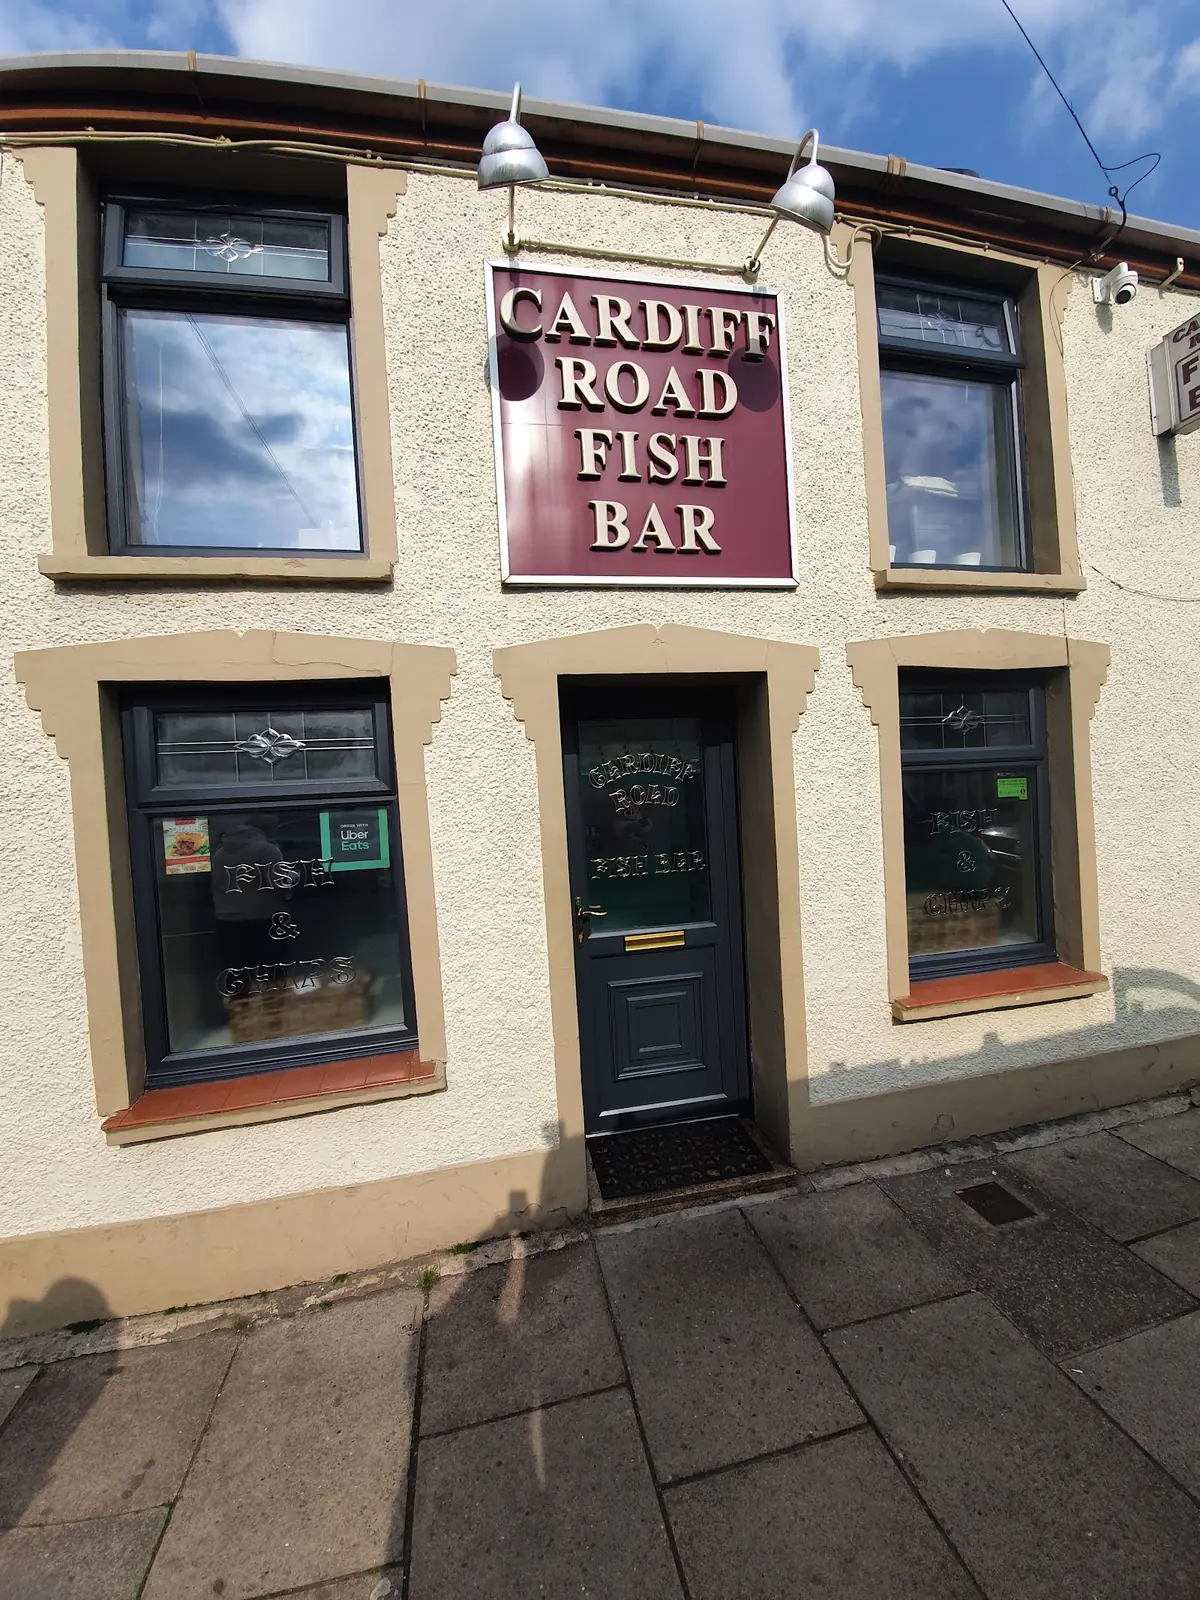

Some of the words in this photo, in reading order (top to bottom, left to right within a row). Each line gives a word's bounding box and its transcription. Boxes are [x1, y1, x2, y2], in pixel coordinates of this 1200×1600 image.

[500, 287, 775, 361] CARDIFF
[555, 356, 738, 420] ROAD
[574, 428, 727, 487] FISH
[588, 500, 722, 554] BAR
[588, 752, 697, 788] CARDIFF
[609, 784, 680, 812] ROAD
[340, 829, 369, 840] Uber
[930, 808, 998, 836] FISH
[341, 841, 370, 851] Eats
[956, 850, 977, 872] &
[223, 857, 335, 893] FISH
[590, 854, 649, 879] FISH
[655, 850, 706, 874] BAR
[268, 911, 300, 940] &
[216, 955, 357, 997] CHIPS
